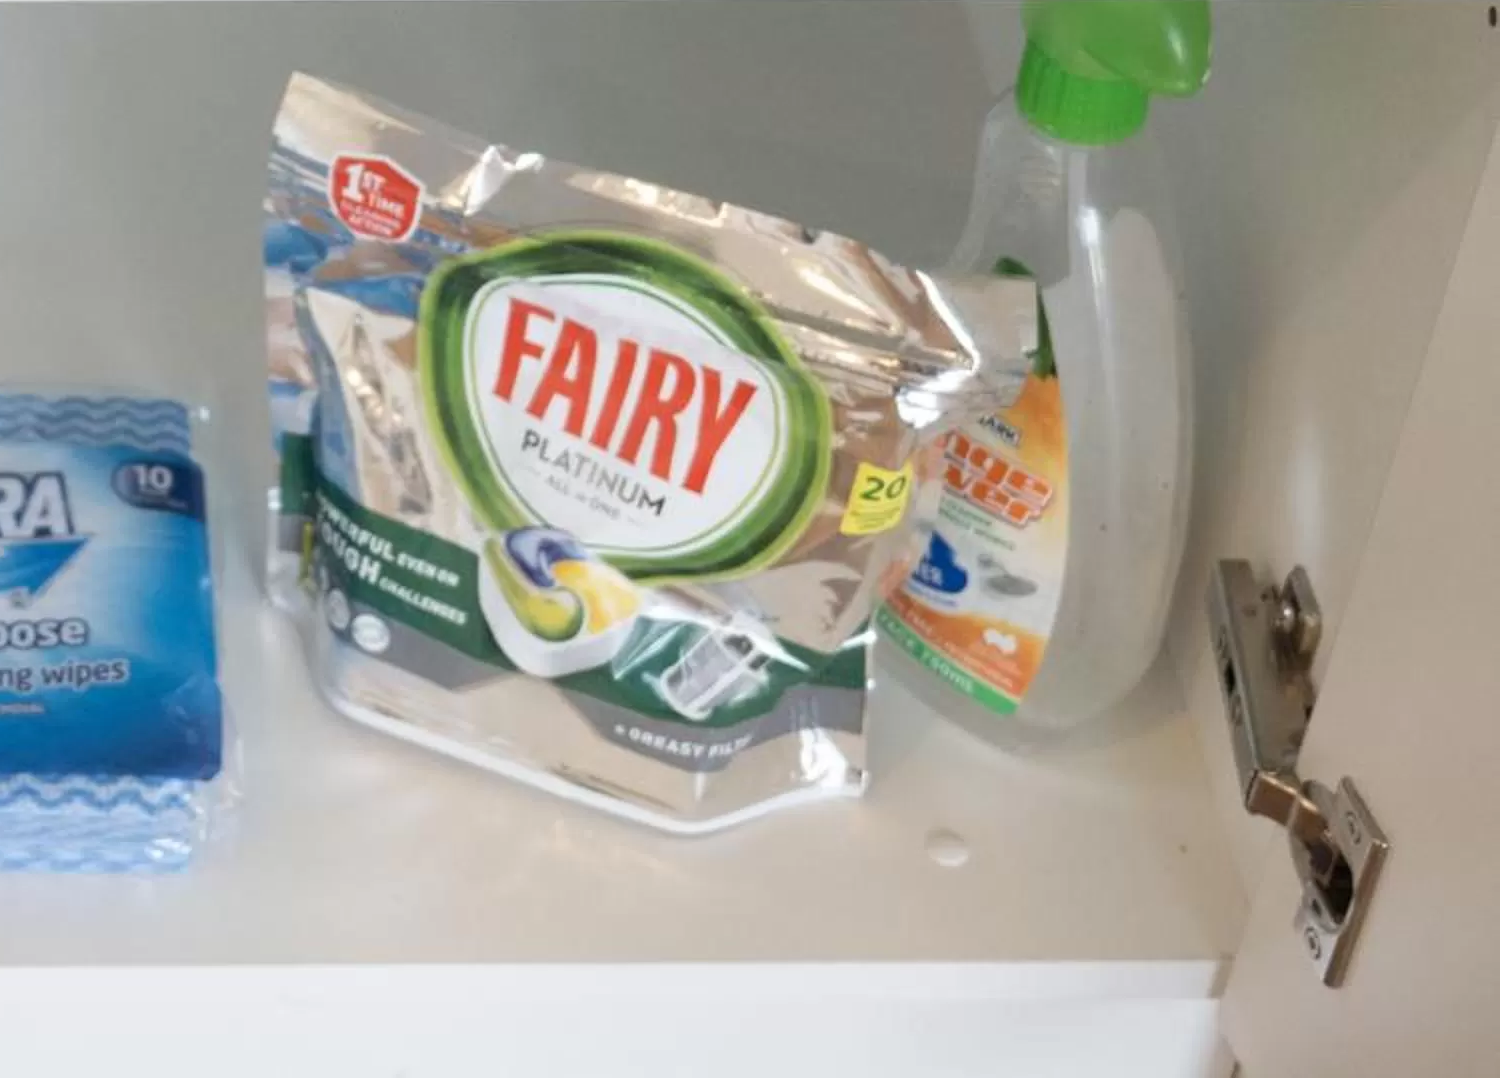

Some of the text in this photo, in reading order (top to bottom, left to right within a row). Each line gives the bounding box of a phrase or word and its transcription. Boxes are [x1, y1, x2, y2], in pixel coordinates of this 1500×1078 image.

[492, 296, 758, 497] FAIRY
[132, 465, 173, 489] 10
[521, 427, 667, 517] PLATINUM
[859, 475, 907, 502] 20
[379, 576, 468, 626] CHALLENGES
[40, 658, 127, 688] wipes
[628, 726, 705, 759] GREASY
